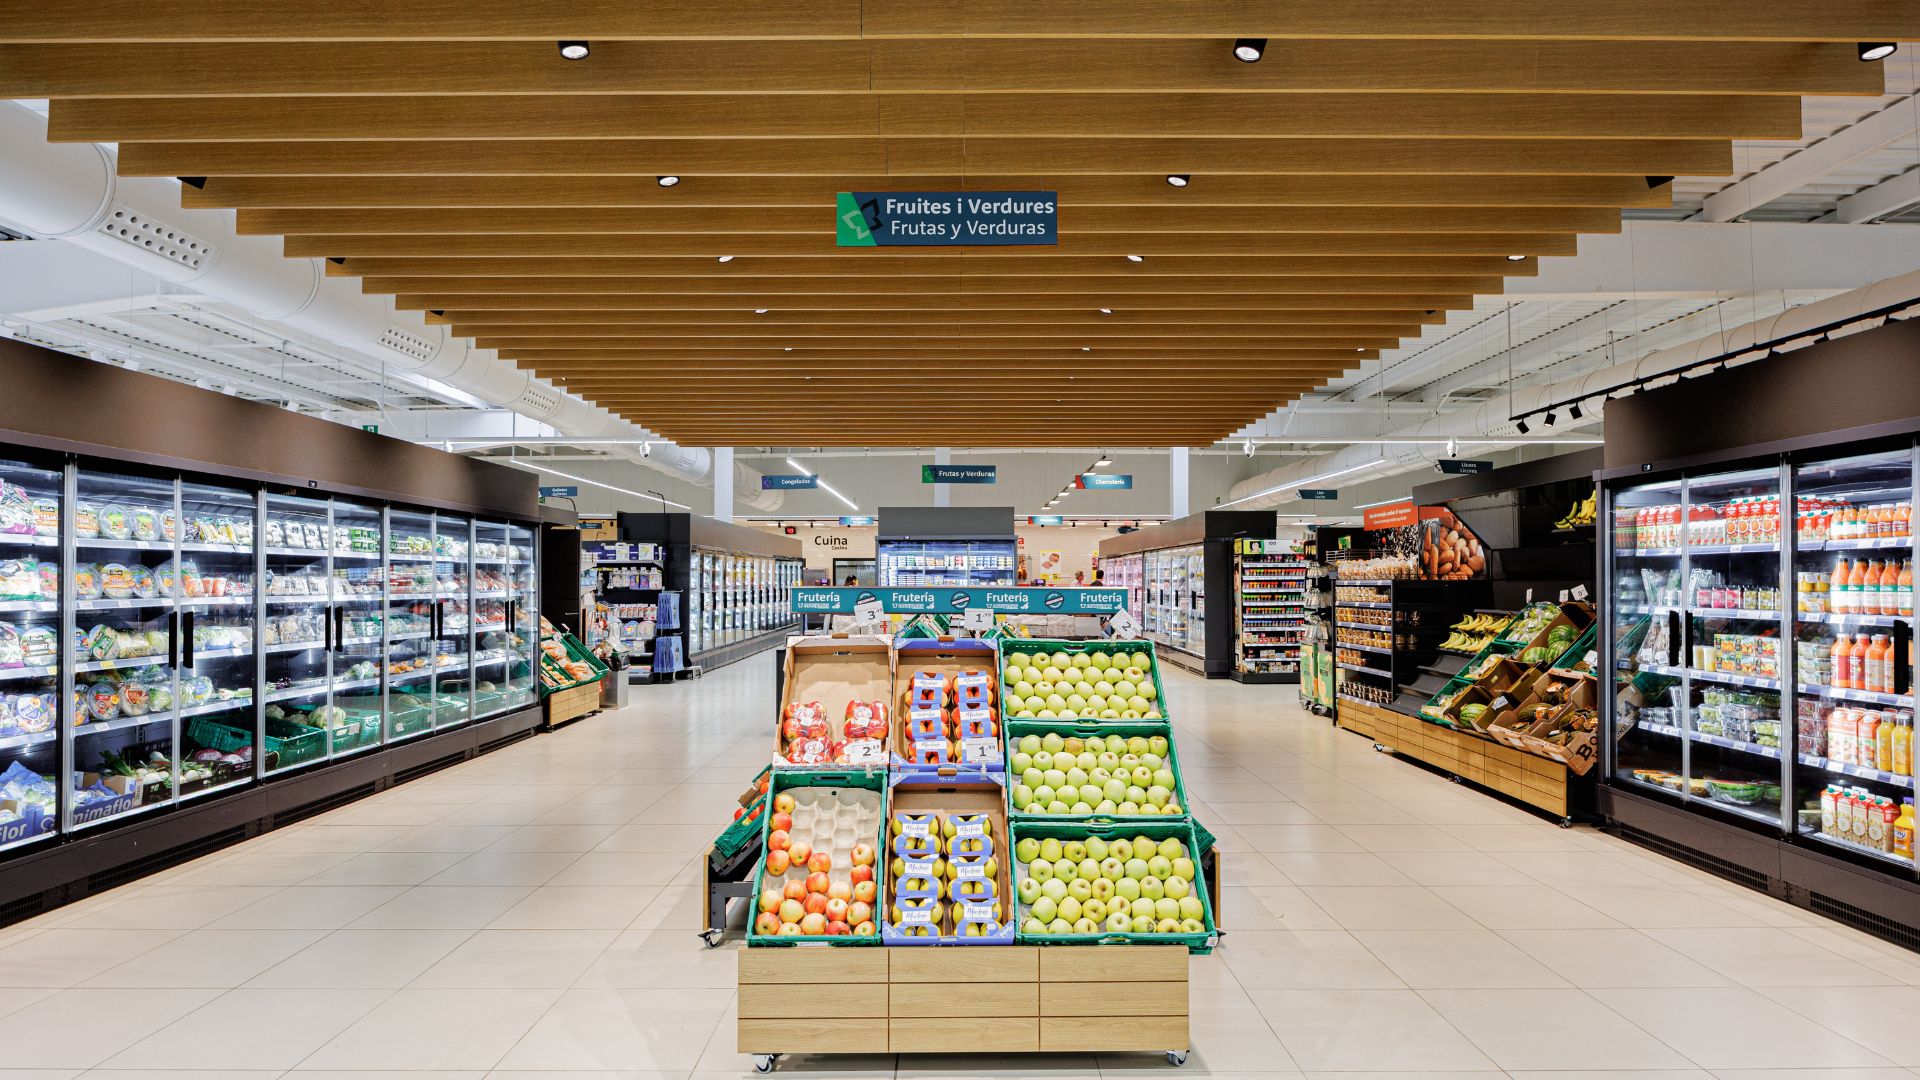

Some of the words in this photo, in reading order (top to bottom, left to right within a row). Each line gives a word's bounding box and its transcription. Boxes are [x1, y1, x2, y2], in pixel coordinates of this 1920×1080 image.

[886, 198, 951, 215] Fruites
[957, 198, 962, 214] i
[967, 198, 1054, 215] Verdures
[891, 220, 946, 235] Frutas
[950, 223, 961, 240] y
[966, 220, 1046, 235] Verduras
[814, 535, 848, 546] Cuina
[797, 591, 840, 602] Frutería
[892, 591, 935, 602] Frutería
[986, 591, 1029, 602] Frutería
[1080, 591, 1122, 602] Frutería
